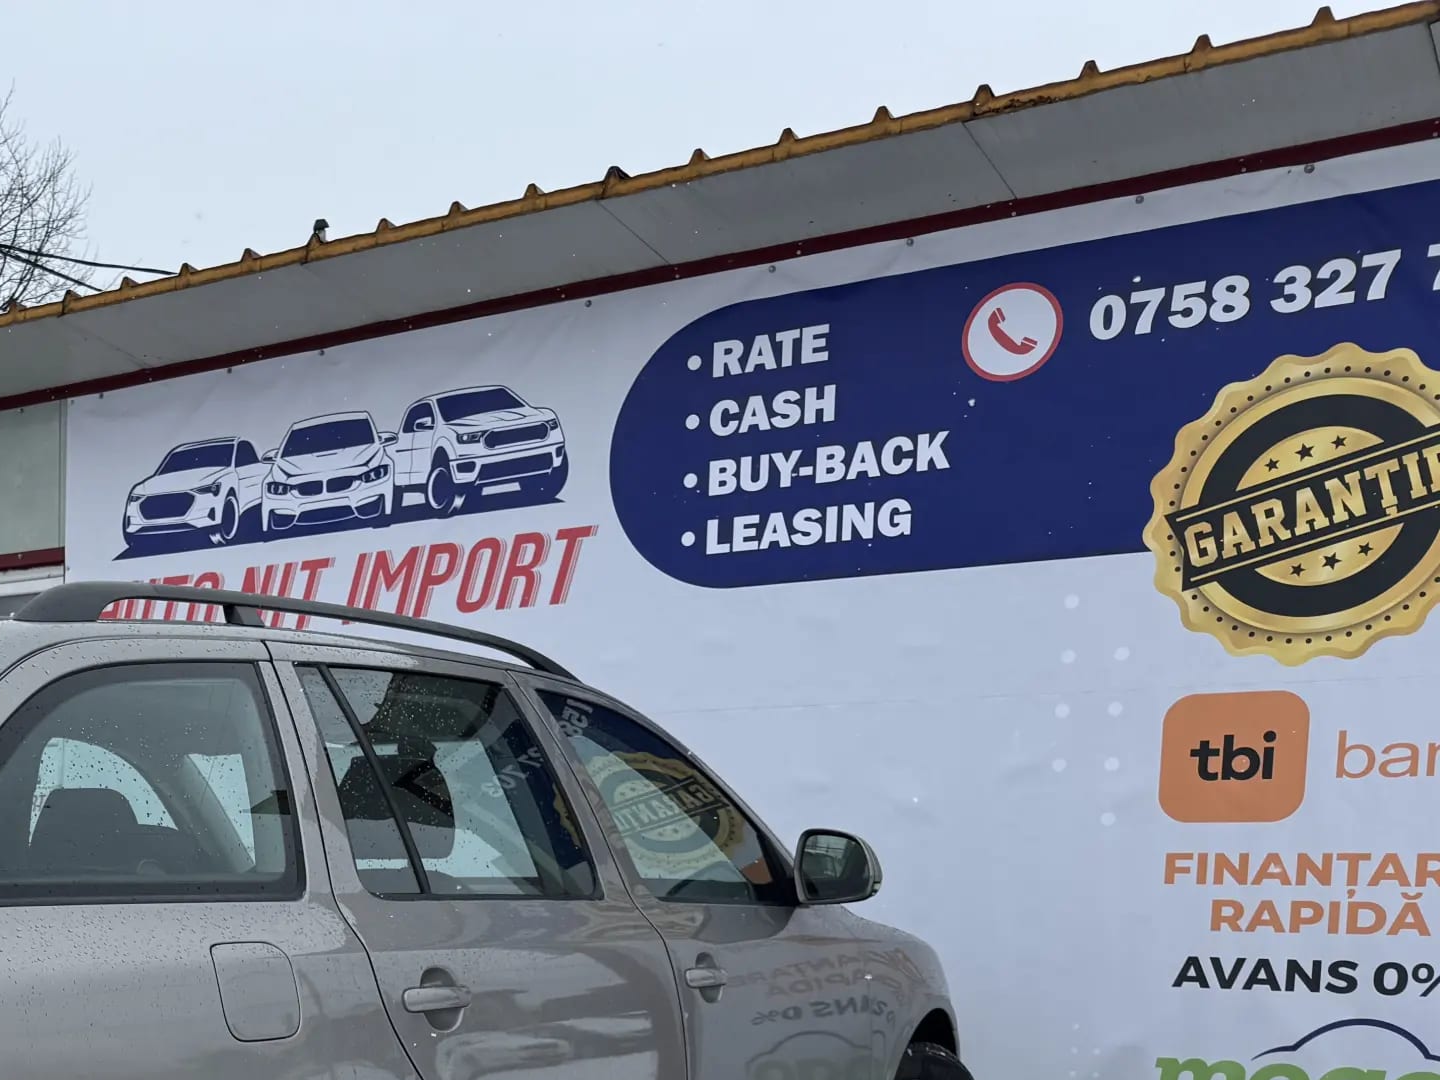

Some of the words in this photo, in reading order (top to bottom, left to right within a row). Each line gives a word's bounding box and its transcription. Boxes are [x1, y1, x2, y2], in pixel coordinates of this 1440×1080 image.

[1089, 274, 1250, 341] 0758
[1270, 249, 1402, 314] 327
[712, 323, 830, 378] RATE
[709, 384, 836, 437] CASH
[708, 430, 951, 496] BUY-BACK
[706, 498, 912, 555] LEASING
[342, 525, 599, 626] IMPORT
[1189, 730, 1278, 782] tbi
[1210, 892, 1432, 937] RAPIDĂ
[1172, 956, 1359, 994] AVANS
